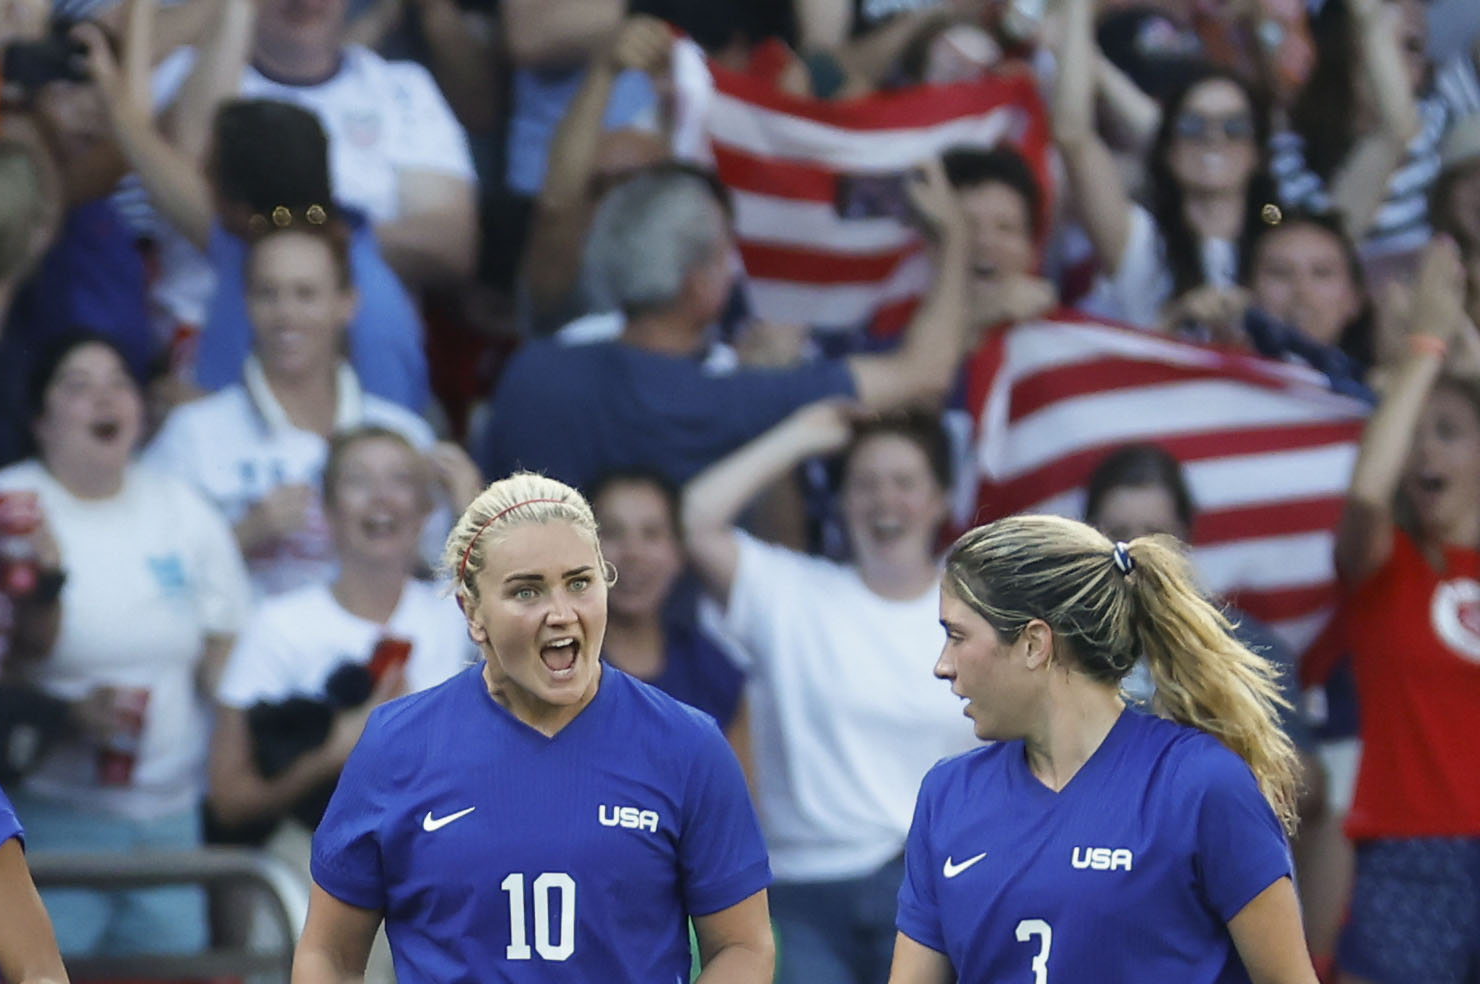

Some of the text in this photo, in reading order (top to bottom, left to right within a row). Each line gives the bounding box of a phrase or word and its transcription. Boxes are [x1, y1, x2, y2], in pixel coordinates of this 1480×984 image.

[598, 804, 659, 833] USA
[1071, 846, 1133, 871] USA
[501, 872, 576, 961] 10
